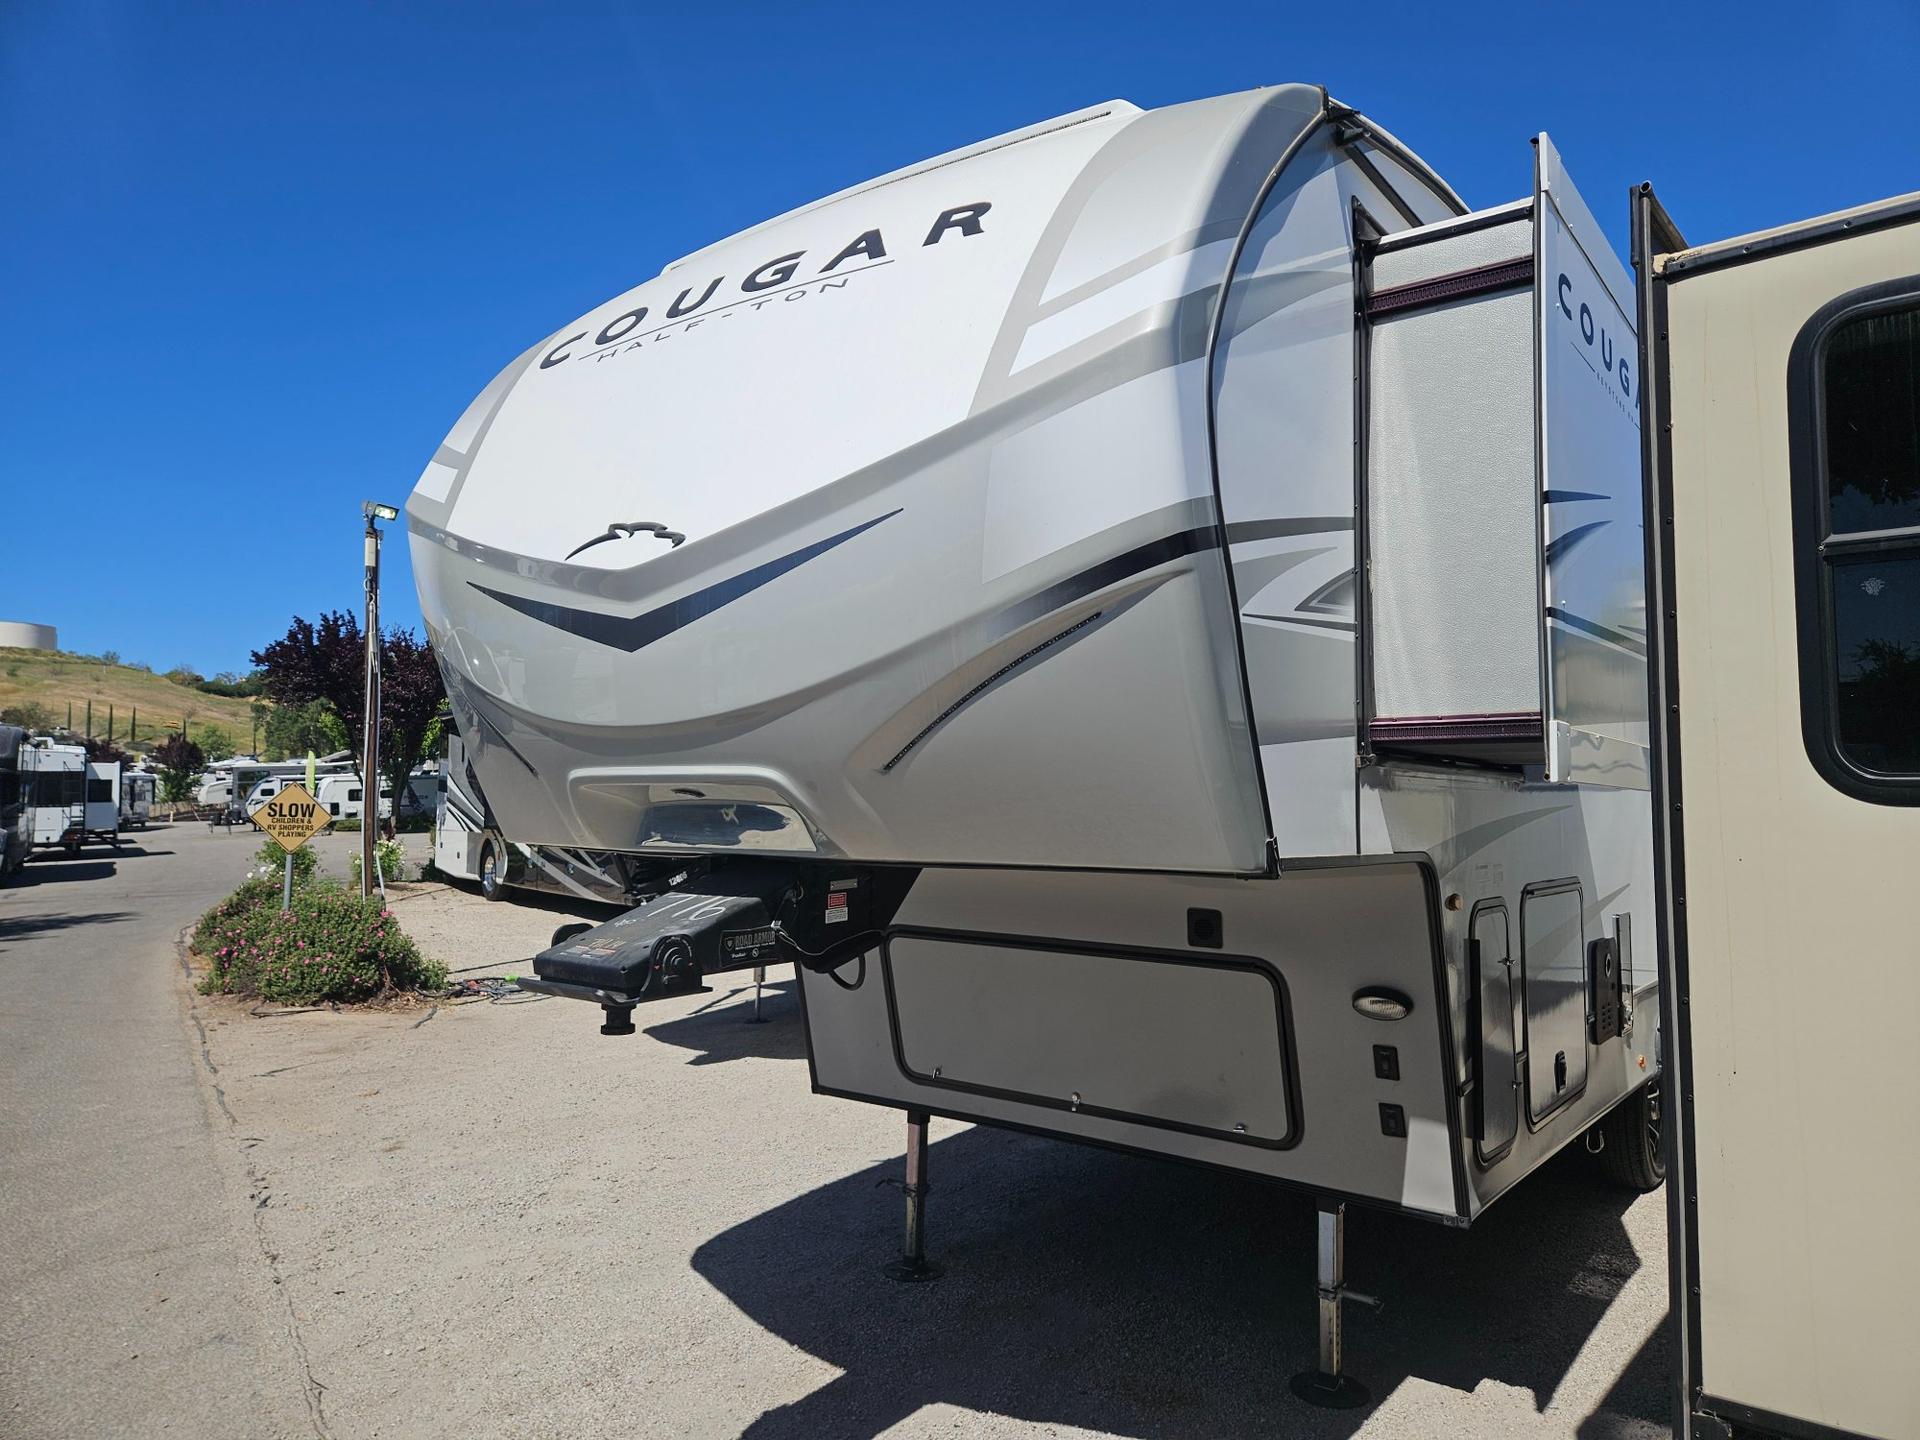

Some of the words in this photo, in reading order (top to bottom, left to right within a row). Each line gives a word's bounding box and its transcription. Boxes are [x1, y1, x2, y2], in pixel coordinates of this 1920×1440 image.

[539, 201, 992, 370] COUGAR
[596, 278, 849, 364] HALF-TON
[1558, 272, 1641, 409] COUG
[267, 802, 316, 818] SLOW
[647, 894, 739, 921] 716
